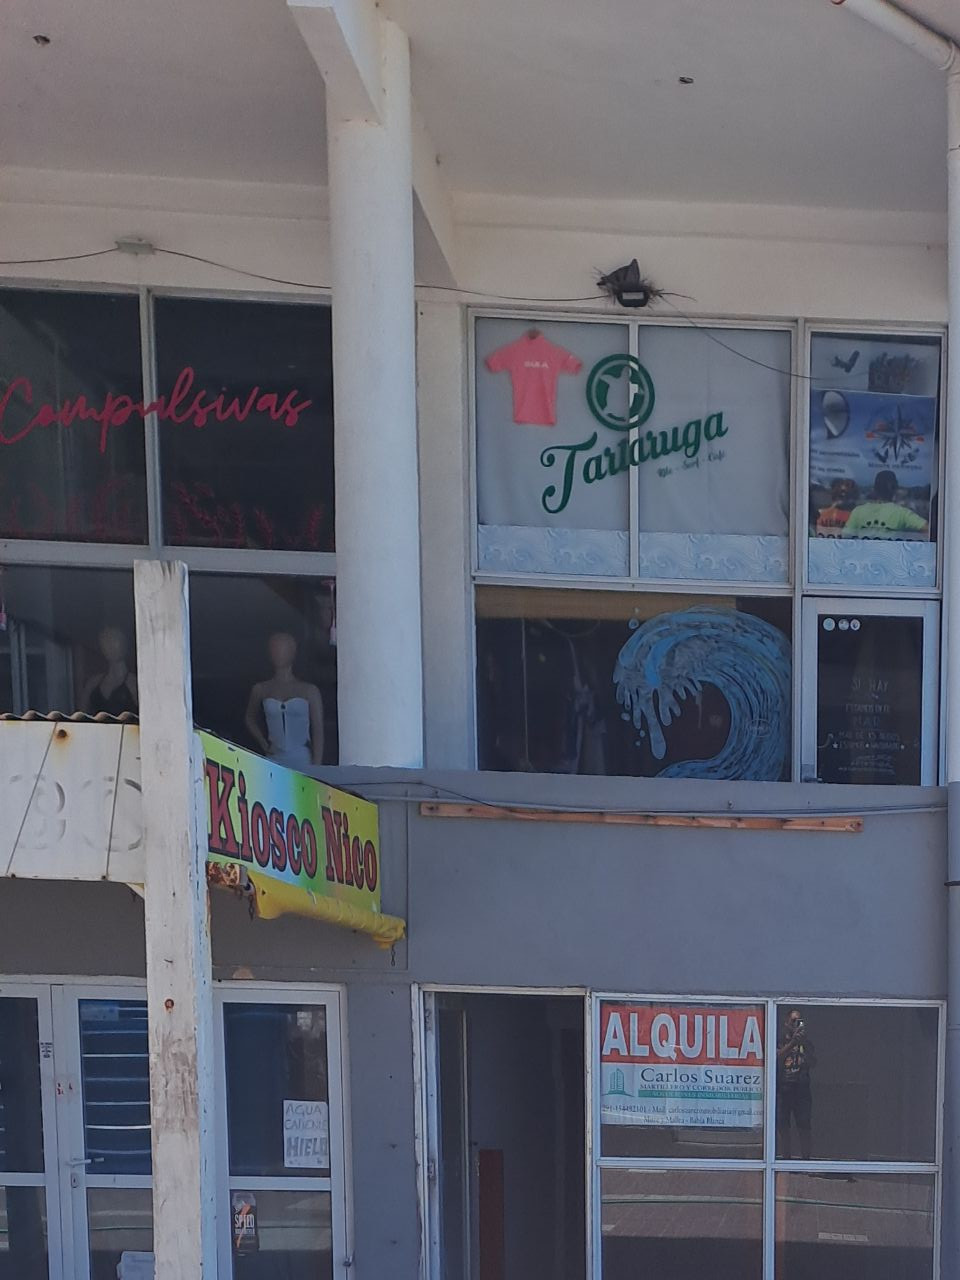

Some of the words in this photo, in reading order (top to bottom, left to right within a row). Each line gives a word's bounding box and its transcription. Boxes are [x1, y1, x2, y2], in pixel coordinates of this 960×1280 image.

[0, 366, 312, 453] Compulsivas
[540, 411, 729, 514] Tartaruga
[206, 758, 318, 879] Kiosco
[321, 804, 378, 893] Nico
[602, 1012, 764, 1061] ALQUILA
[640, 1067, 698, 1083] Carlos
[704, 1069, 761, 1085] Suarez
[285, 1103, 322, 1117] AGUA
[286, 1136, 328, 1157] HIELO
